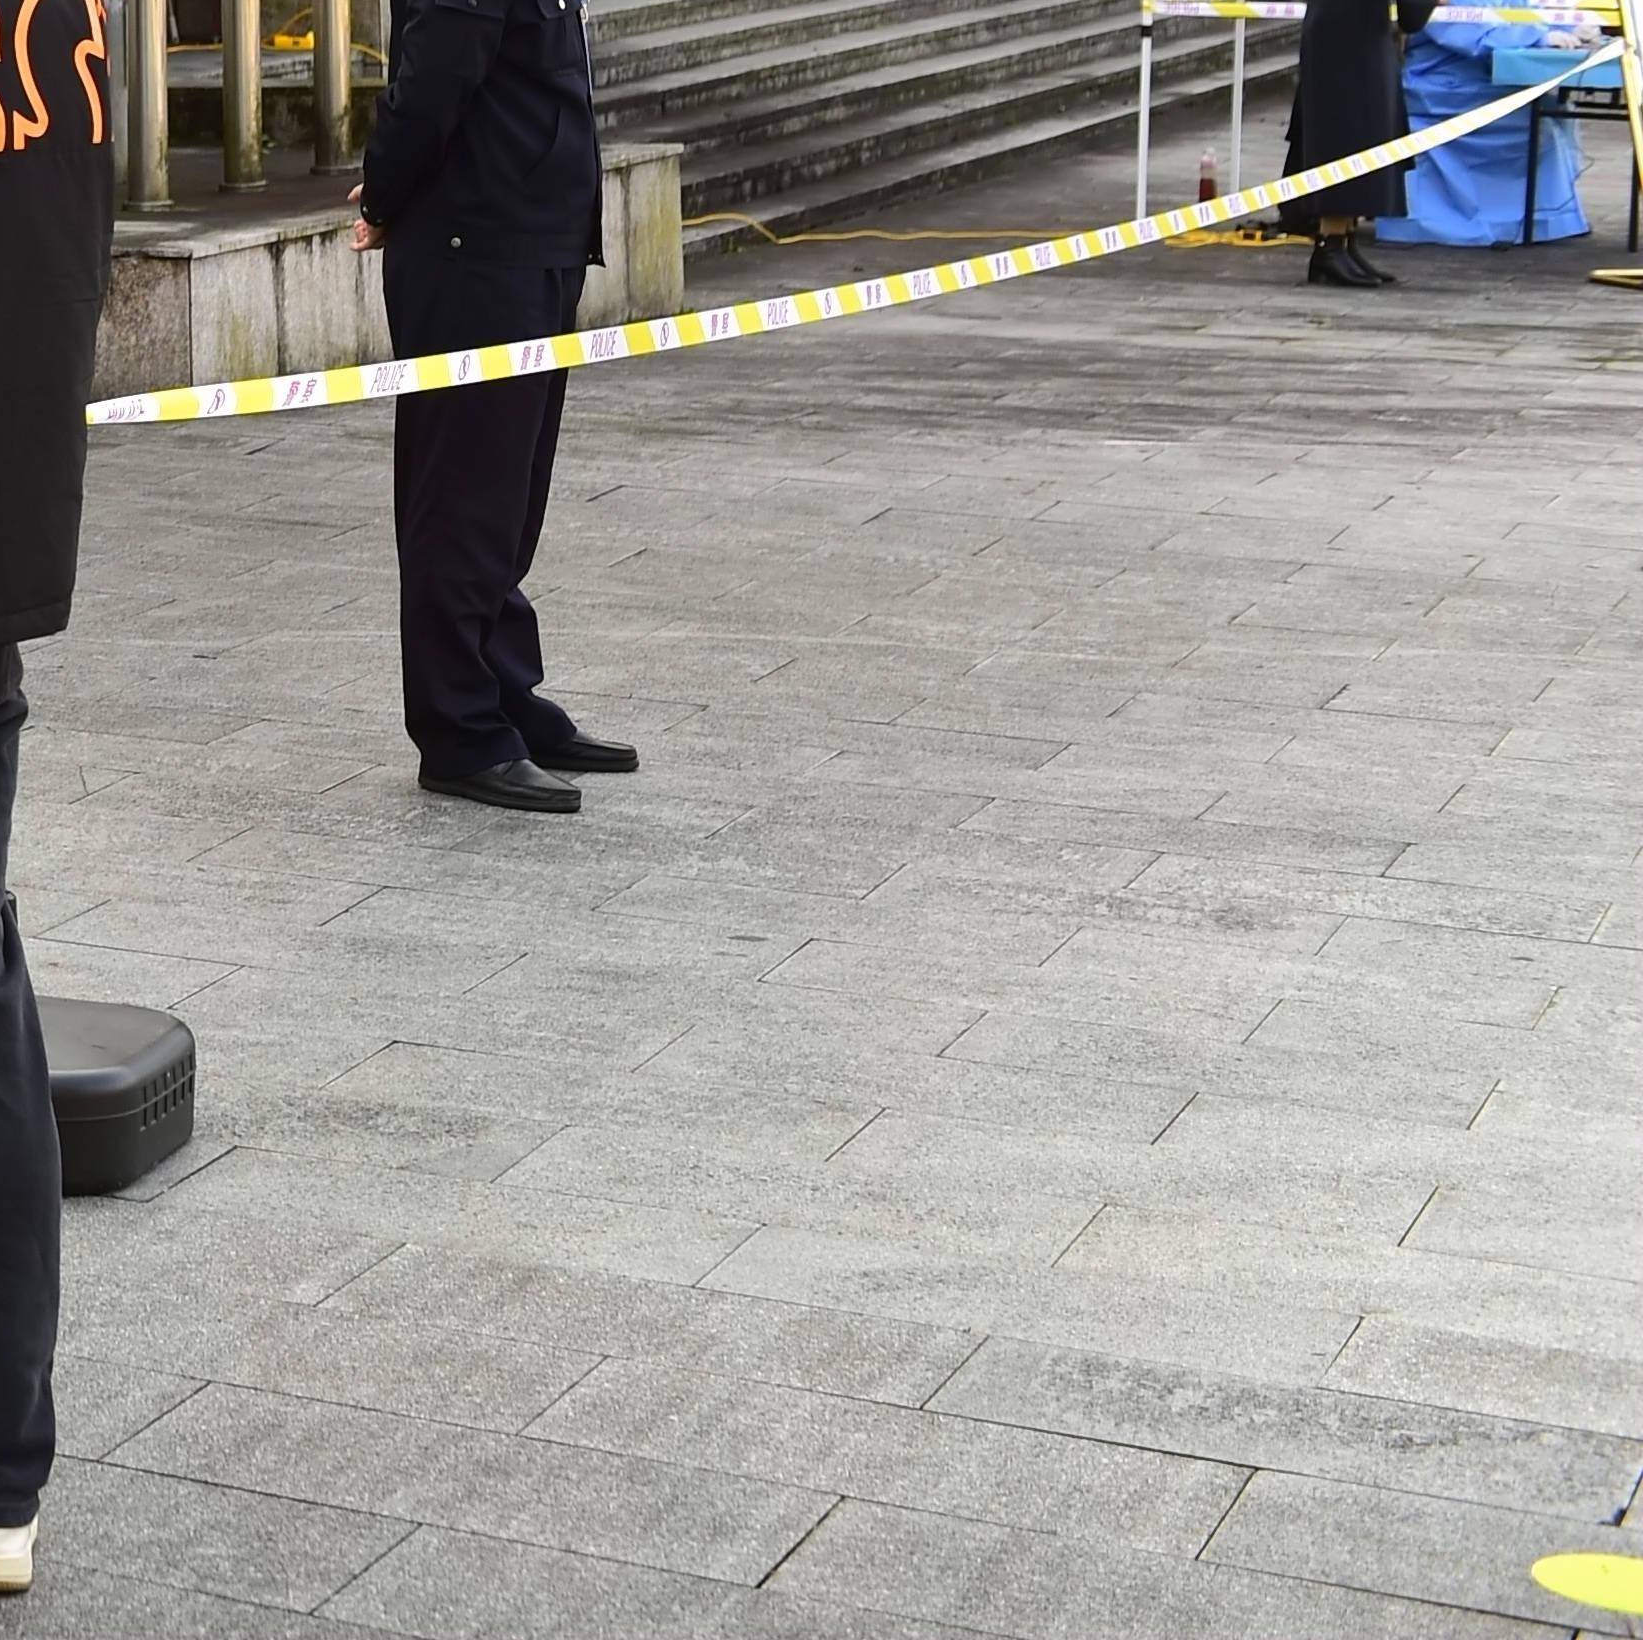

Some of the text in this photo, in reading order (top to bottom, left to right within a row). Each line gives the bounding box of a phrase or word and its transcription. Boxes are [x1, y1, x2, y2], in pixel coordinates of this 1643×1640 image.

[370, 363, 408, 393] POLICE
[590, 330, 618, 359] POLICE
[767, 300, 789, 326] POLICE
